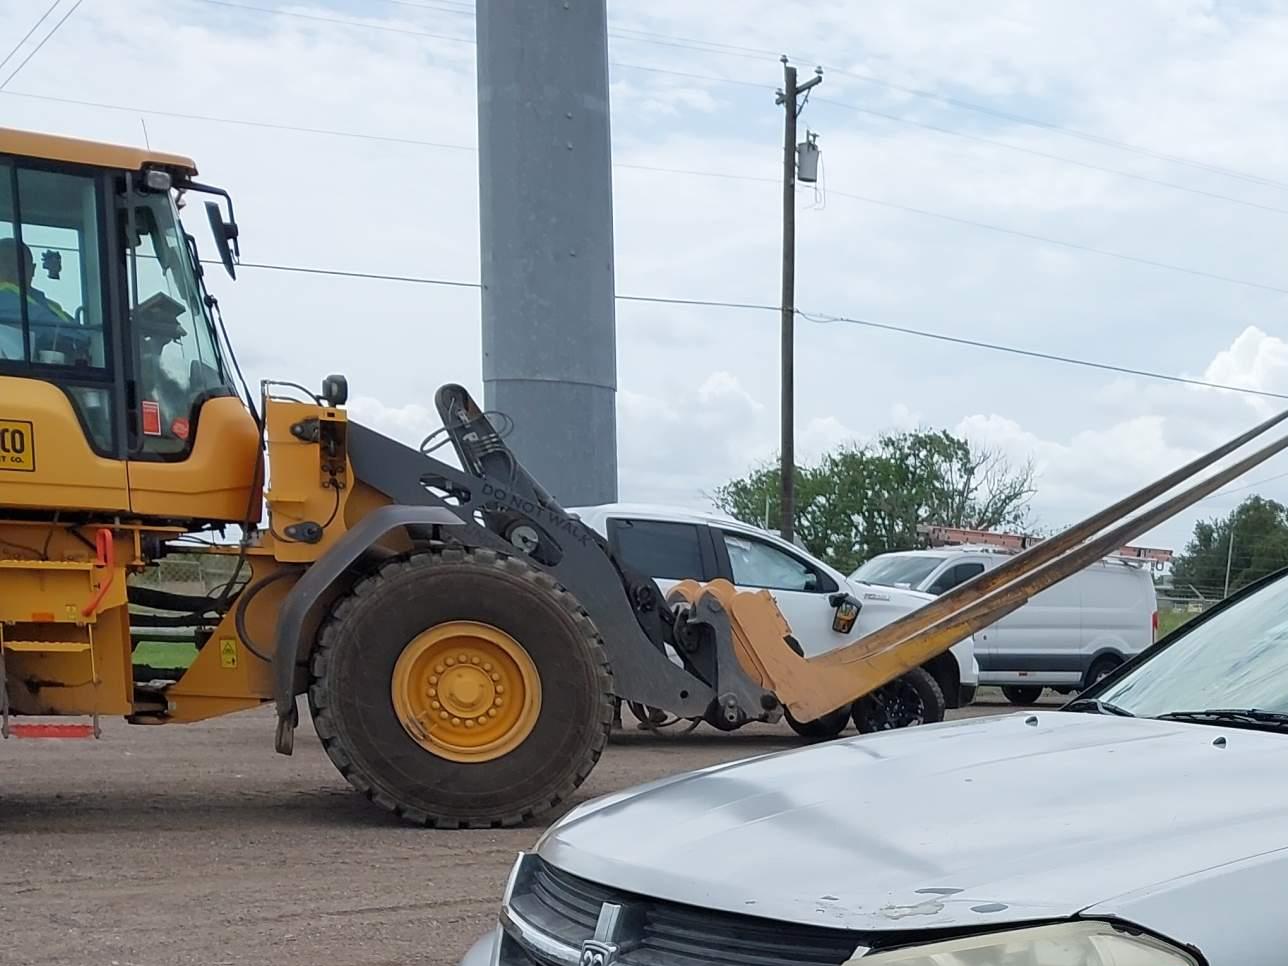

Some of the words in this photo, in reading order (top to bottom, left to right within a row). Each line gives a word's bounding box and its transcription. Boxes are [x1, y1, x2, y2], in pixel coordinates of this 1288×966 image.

[482, 483, 506, 501] DO
[512, 494, 545, 517] NOT
[549, 511, 592, 548] WALK
